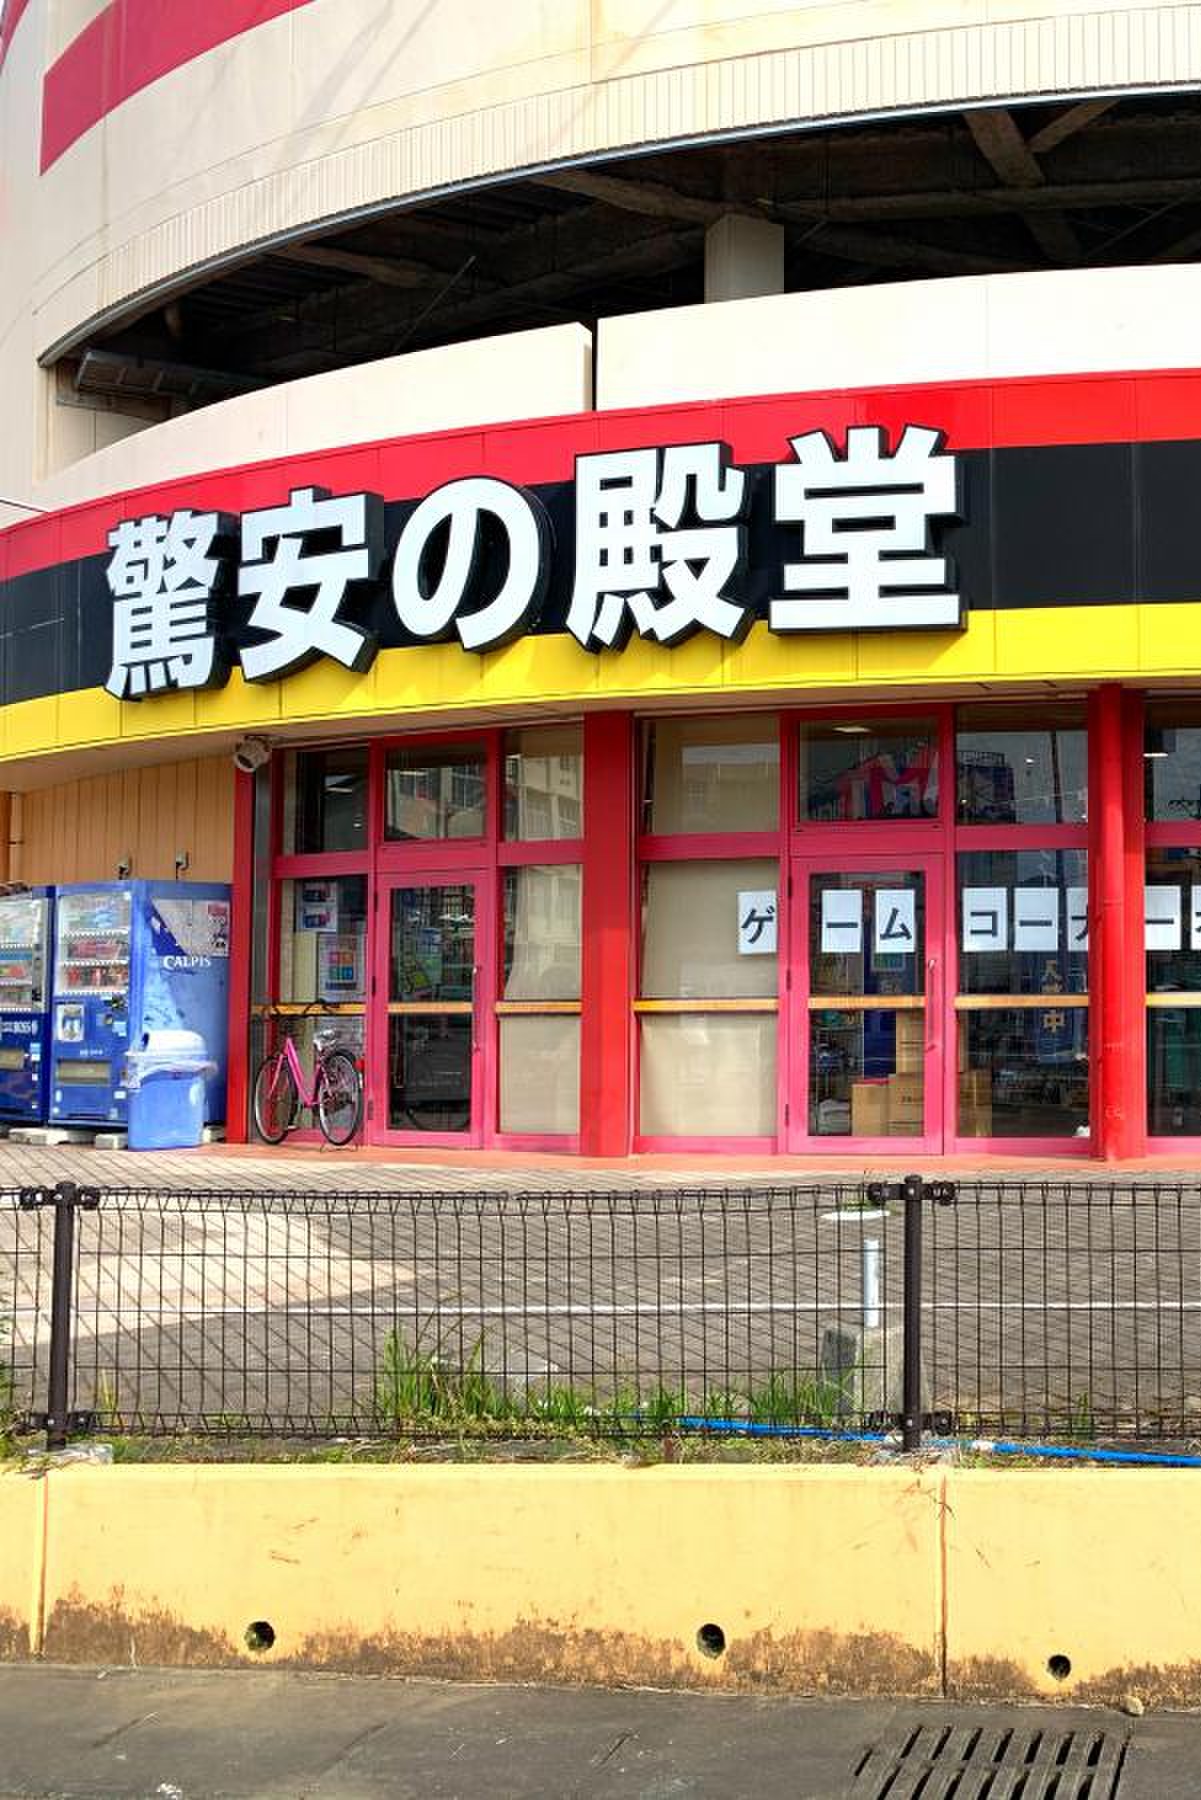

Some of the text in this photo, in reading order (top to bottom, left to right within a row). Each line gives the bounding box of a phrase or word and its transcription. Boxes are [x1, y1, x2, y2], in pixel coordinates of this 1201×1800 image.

[104, 425, 962, 699] 驚安の殿堂
[163, 955, 211, 971] CALPIS
